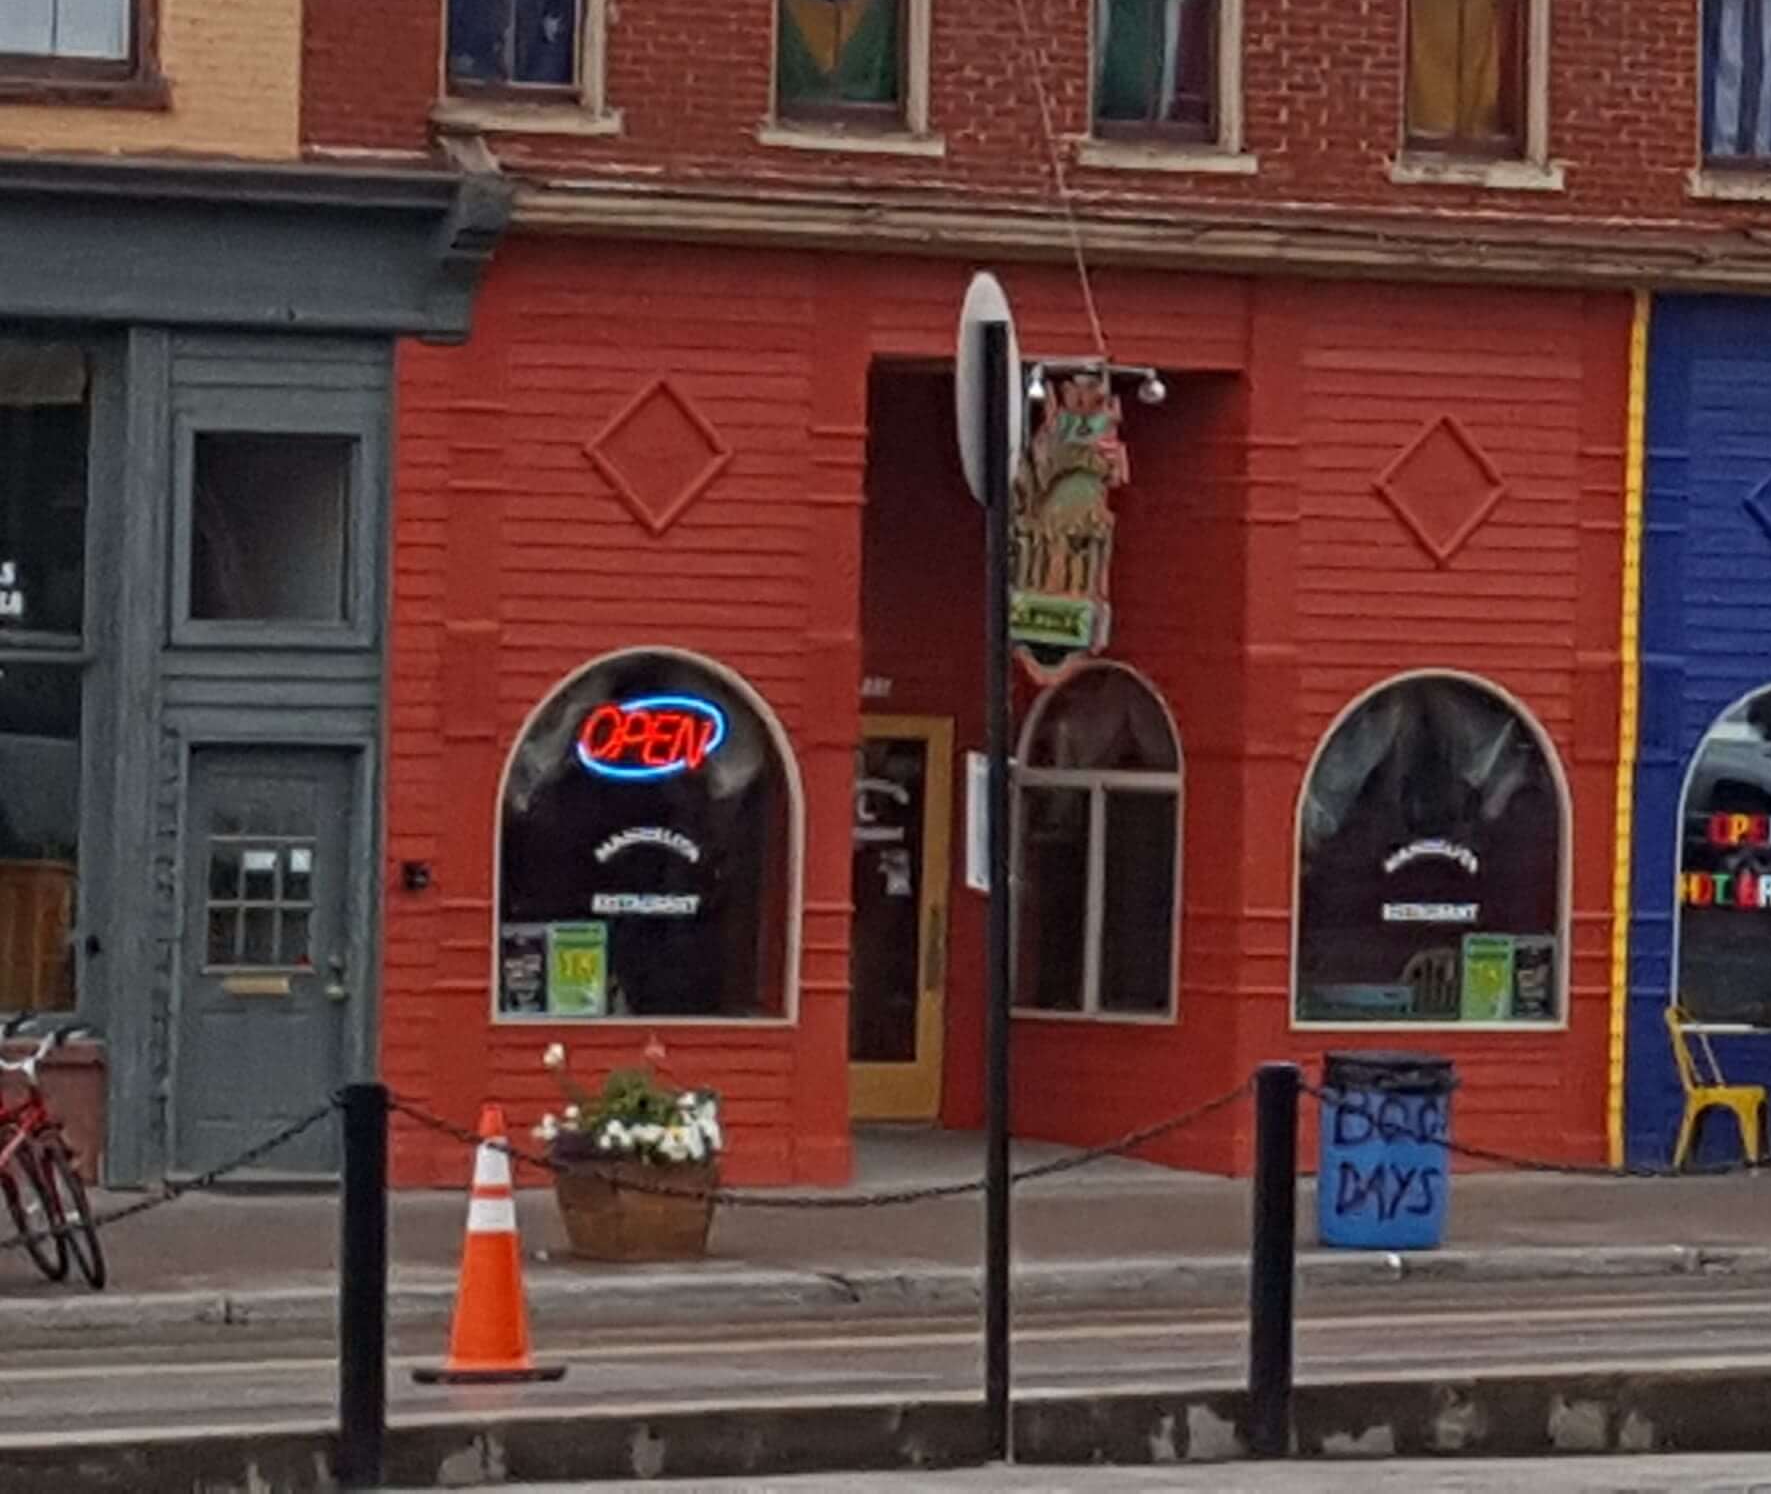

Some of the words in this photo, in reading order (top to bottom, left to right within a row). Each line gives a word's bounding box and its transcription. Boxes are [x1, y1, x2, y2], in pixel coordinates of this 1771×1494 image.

[580, 703, 714, 769] OPEN
[1681, 872, 1729, 906] HOT
[1335, 1161, 1441, 1223] DAYS
